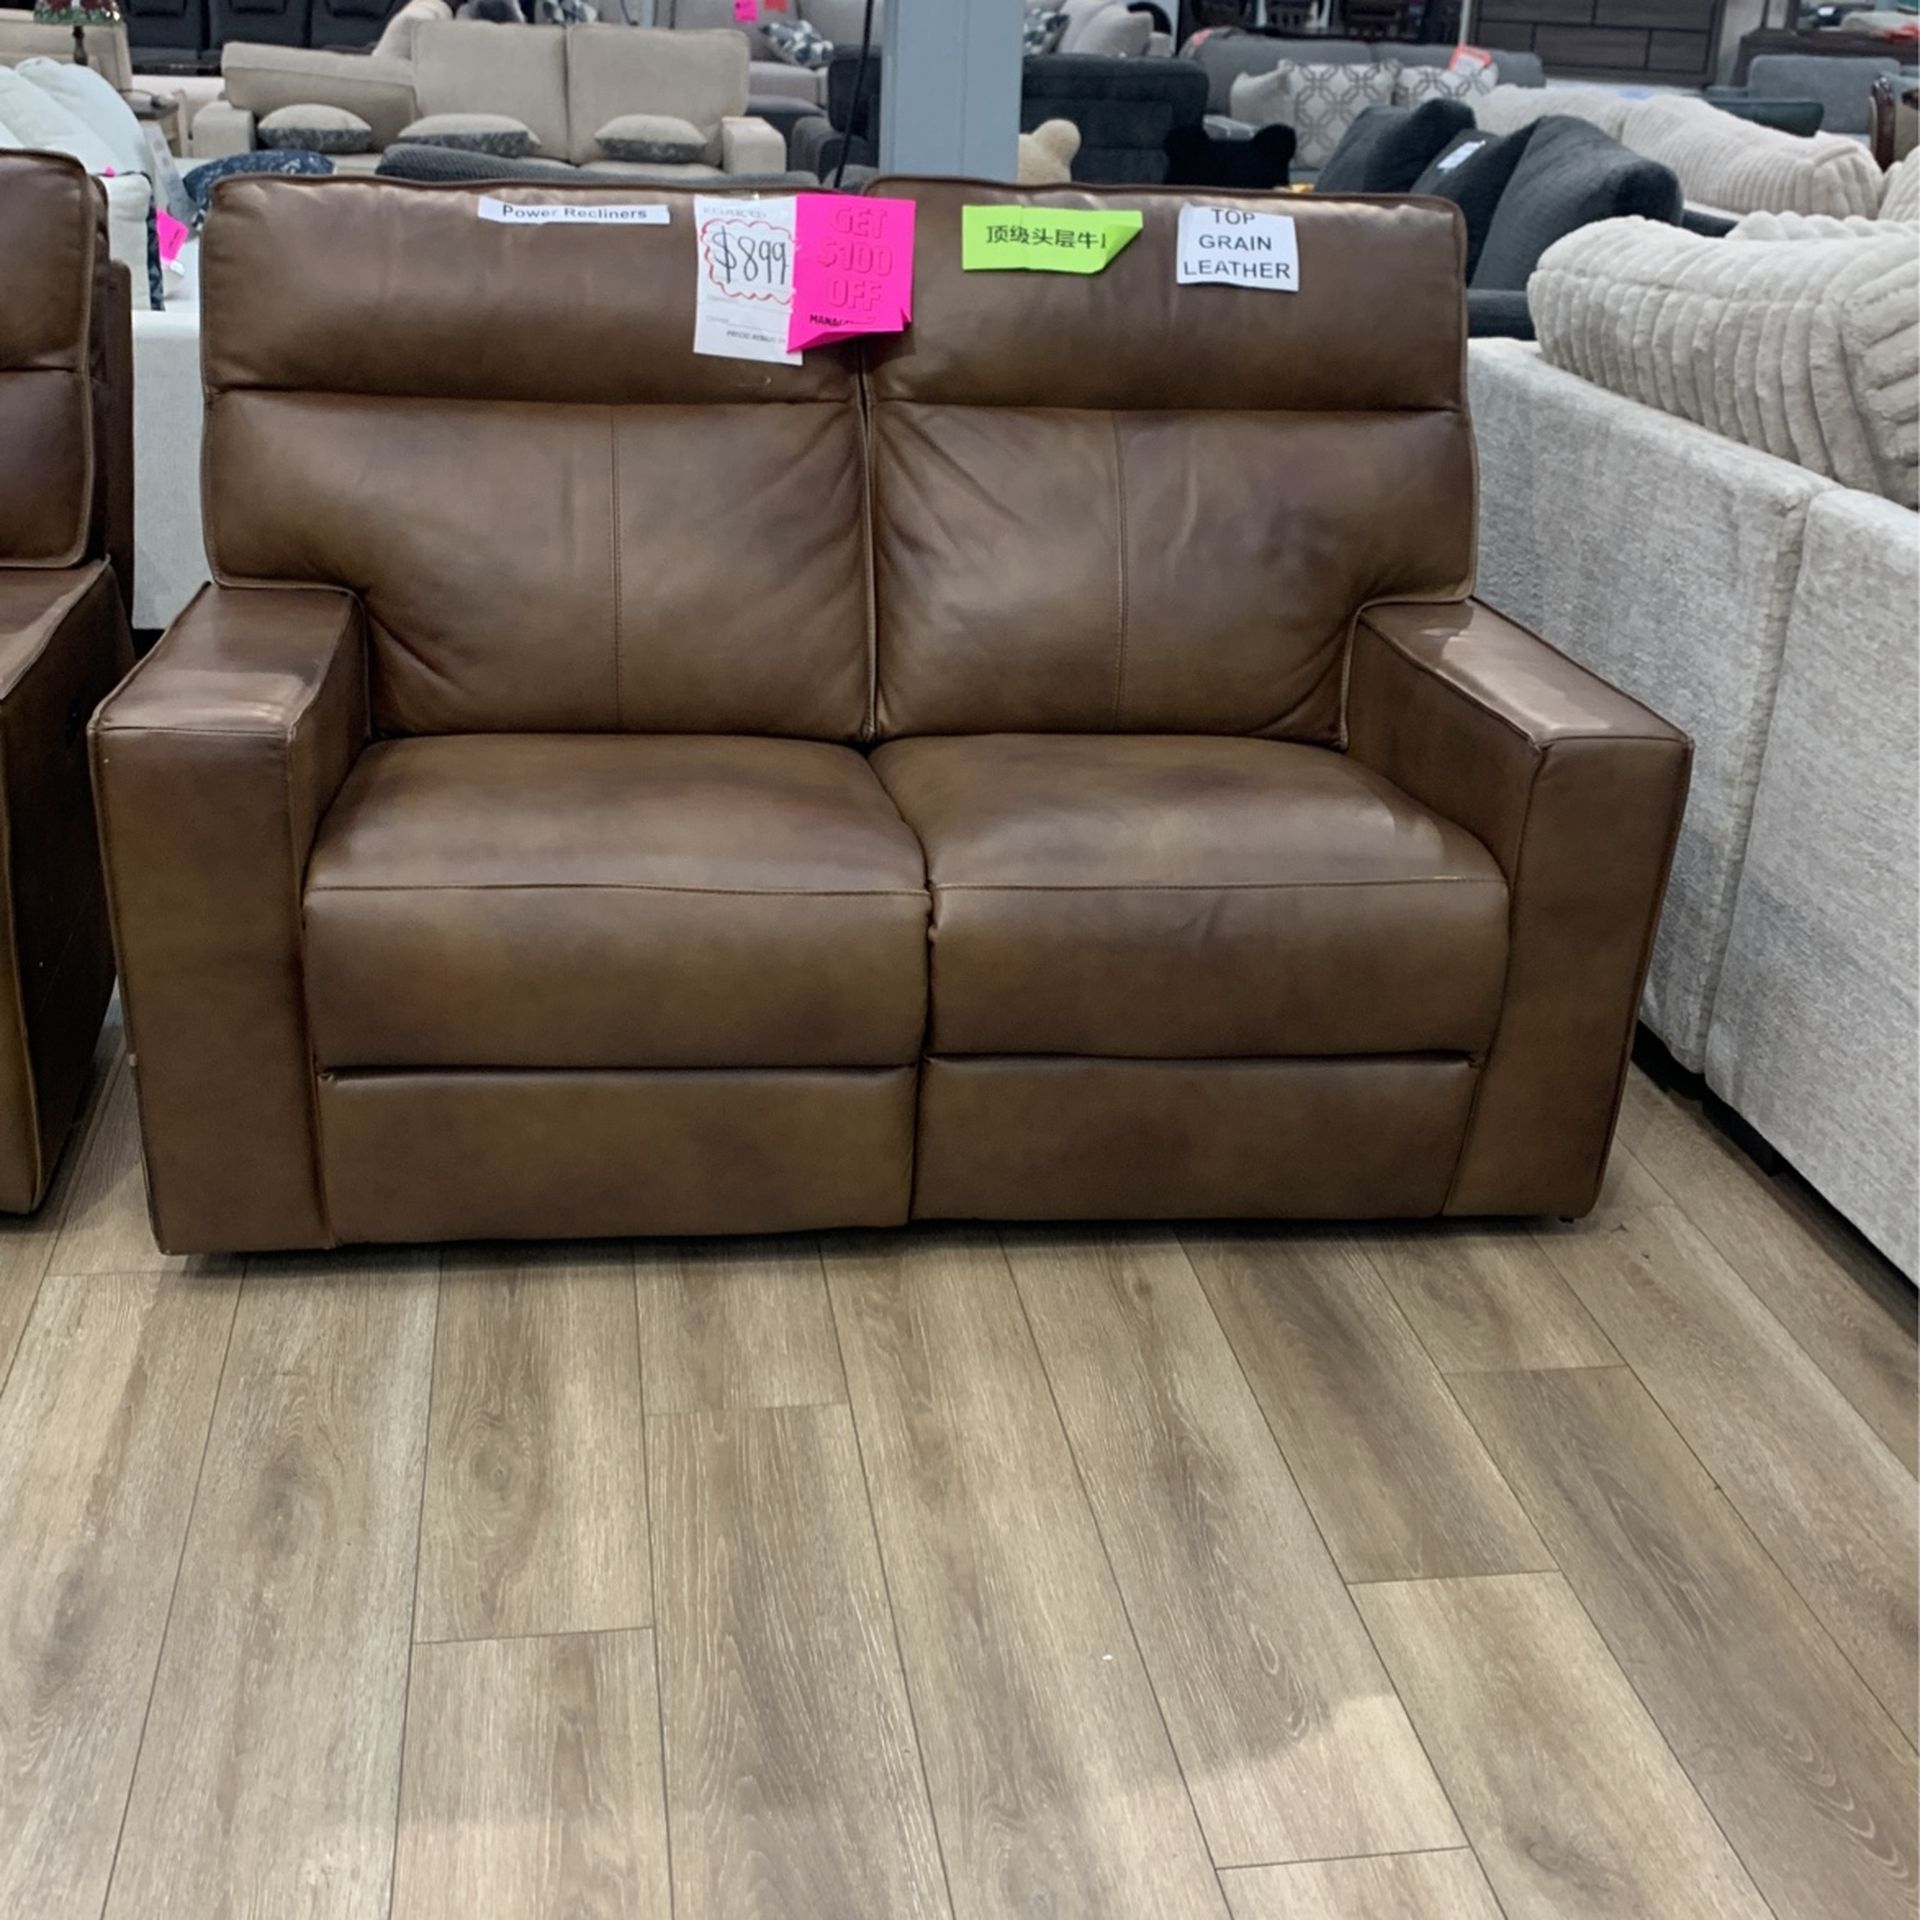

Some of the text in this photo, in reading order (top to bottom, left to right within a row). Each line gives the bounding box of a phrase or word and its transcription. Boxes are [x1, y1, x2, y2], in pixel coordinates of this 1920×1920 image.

[502, 204, 648, 219] Power Recliners
[832, 206, 888, 239] GET
[1211, 208, 1256, 225] TOP
[711, 225, 789, 285] $899
[1199, 234, 1272, 251] GRAIN
[817, 237, 894, 277] $100
[1184, 260, 1291, 280] LEATHER
[829, 277, 882, 312] OFF
